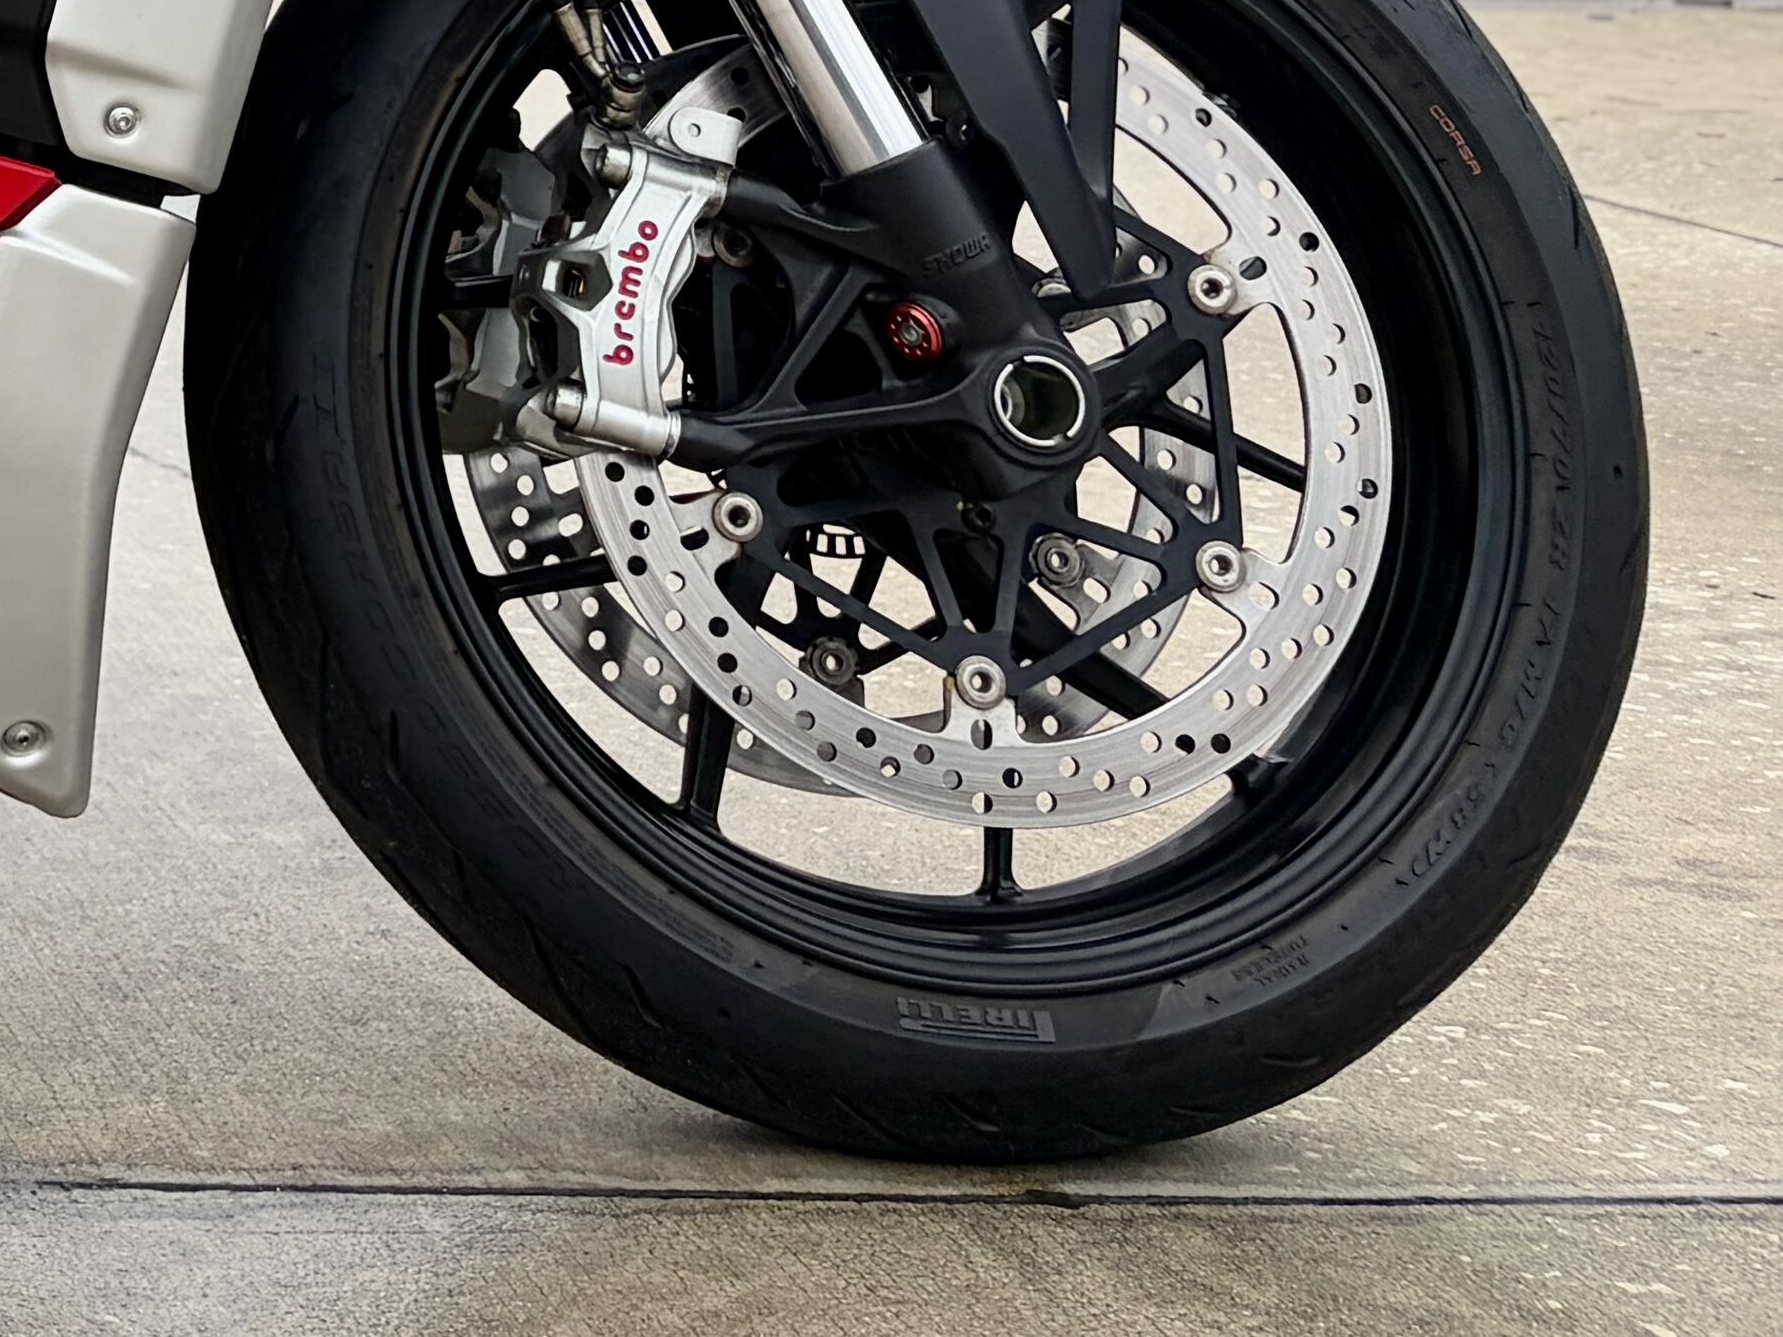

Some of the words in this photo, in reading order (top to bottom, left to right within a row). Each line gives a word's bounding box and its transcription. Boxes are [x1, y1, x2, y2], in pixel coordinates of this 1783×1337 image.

[1429, 104, 1482, 176] CORSA
[922, 234, 991, 279] SHOWA
[602, 220, 659, 366] brembo
[896, 996, 1056, 1043] PIRELLI
